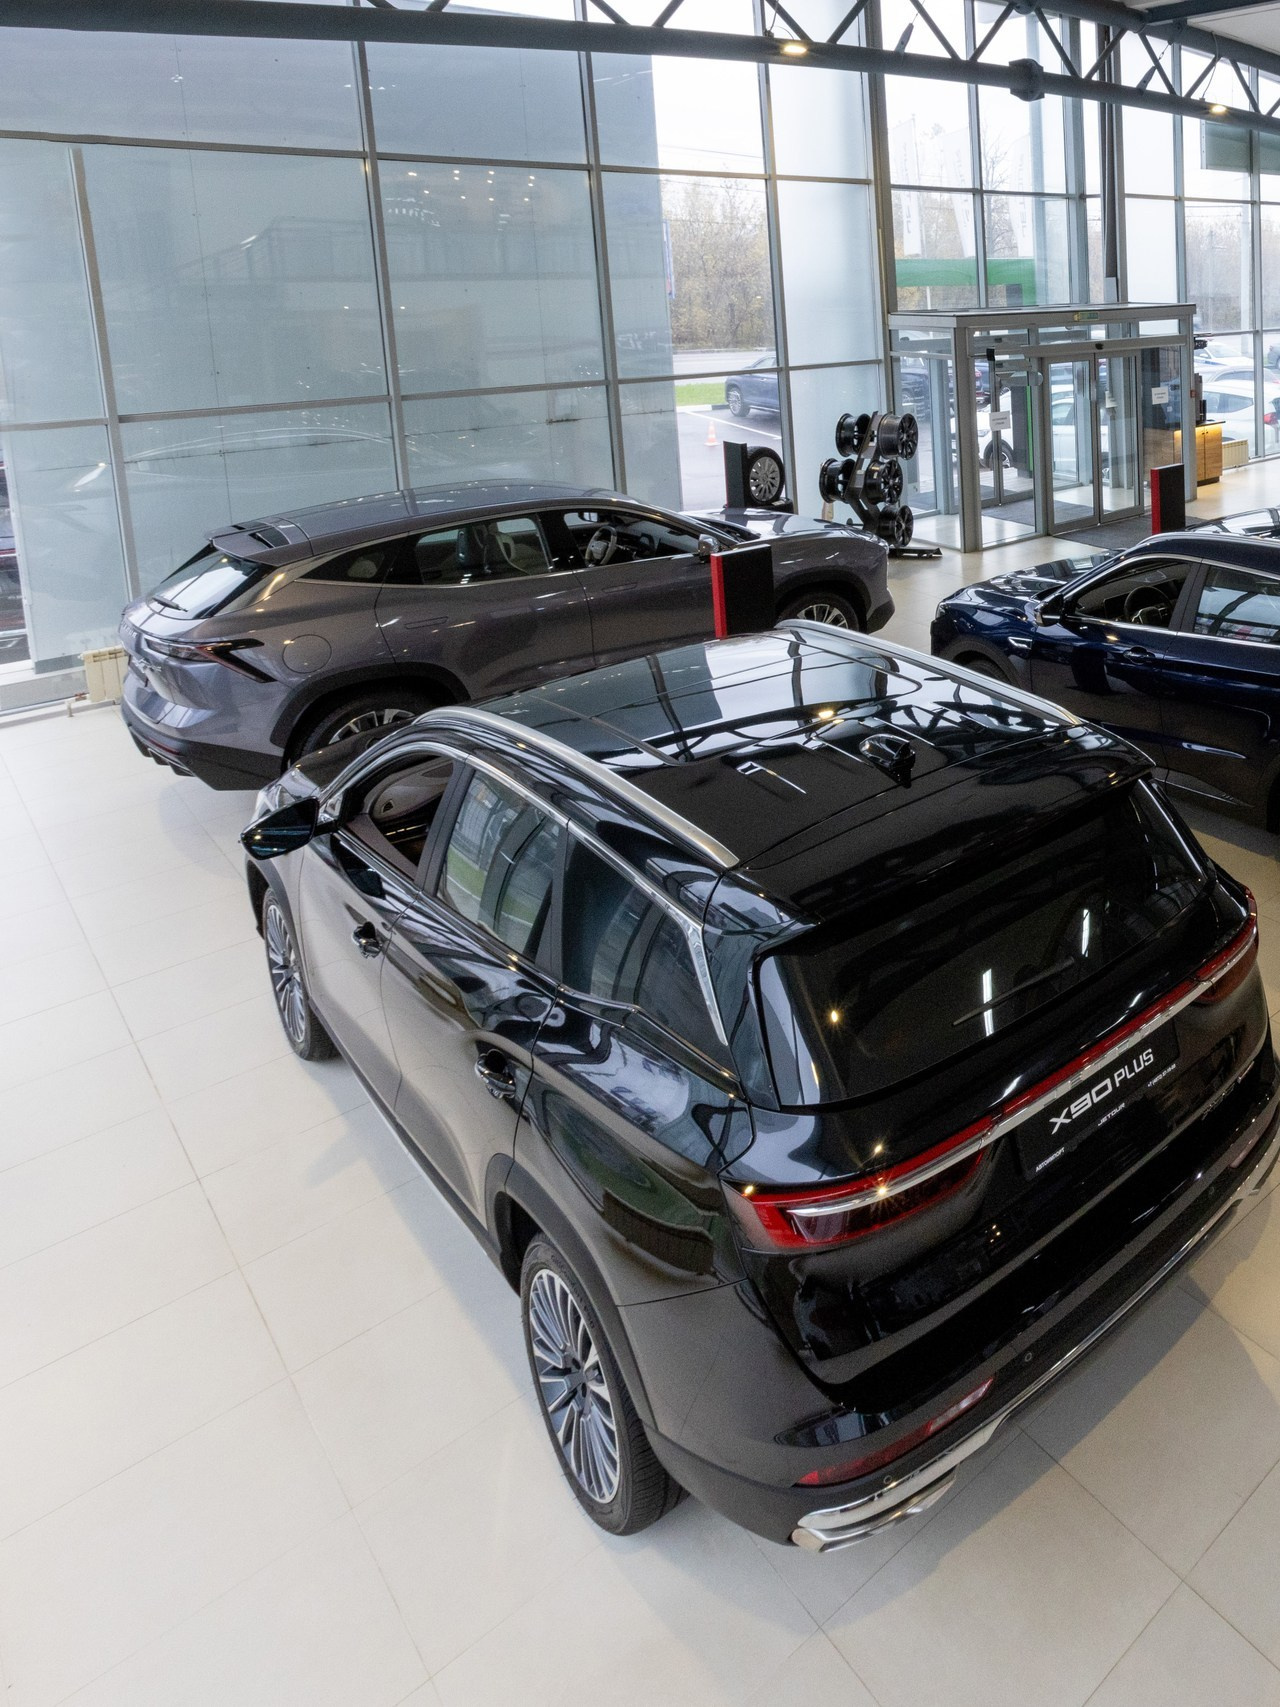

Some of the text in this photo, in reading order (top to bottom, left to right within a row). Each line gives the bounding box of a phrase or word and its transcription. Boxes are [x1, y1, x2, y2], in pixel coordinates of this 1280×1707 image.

[1049, 1078, 1113, 1135] X90
[1114, 1048, 1154, 1087] PLUS
[1098, 1102, 1125, 1126] JETOUR
